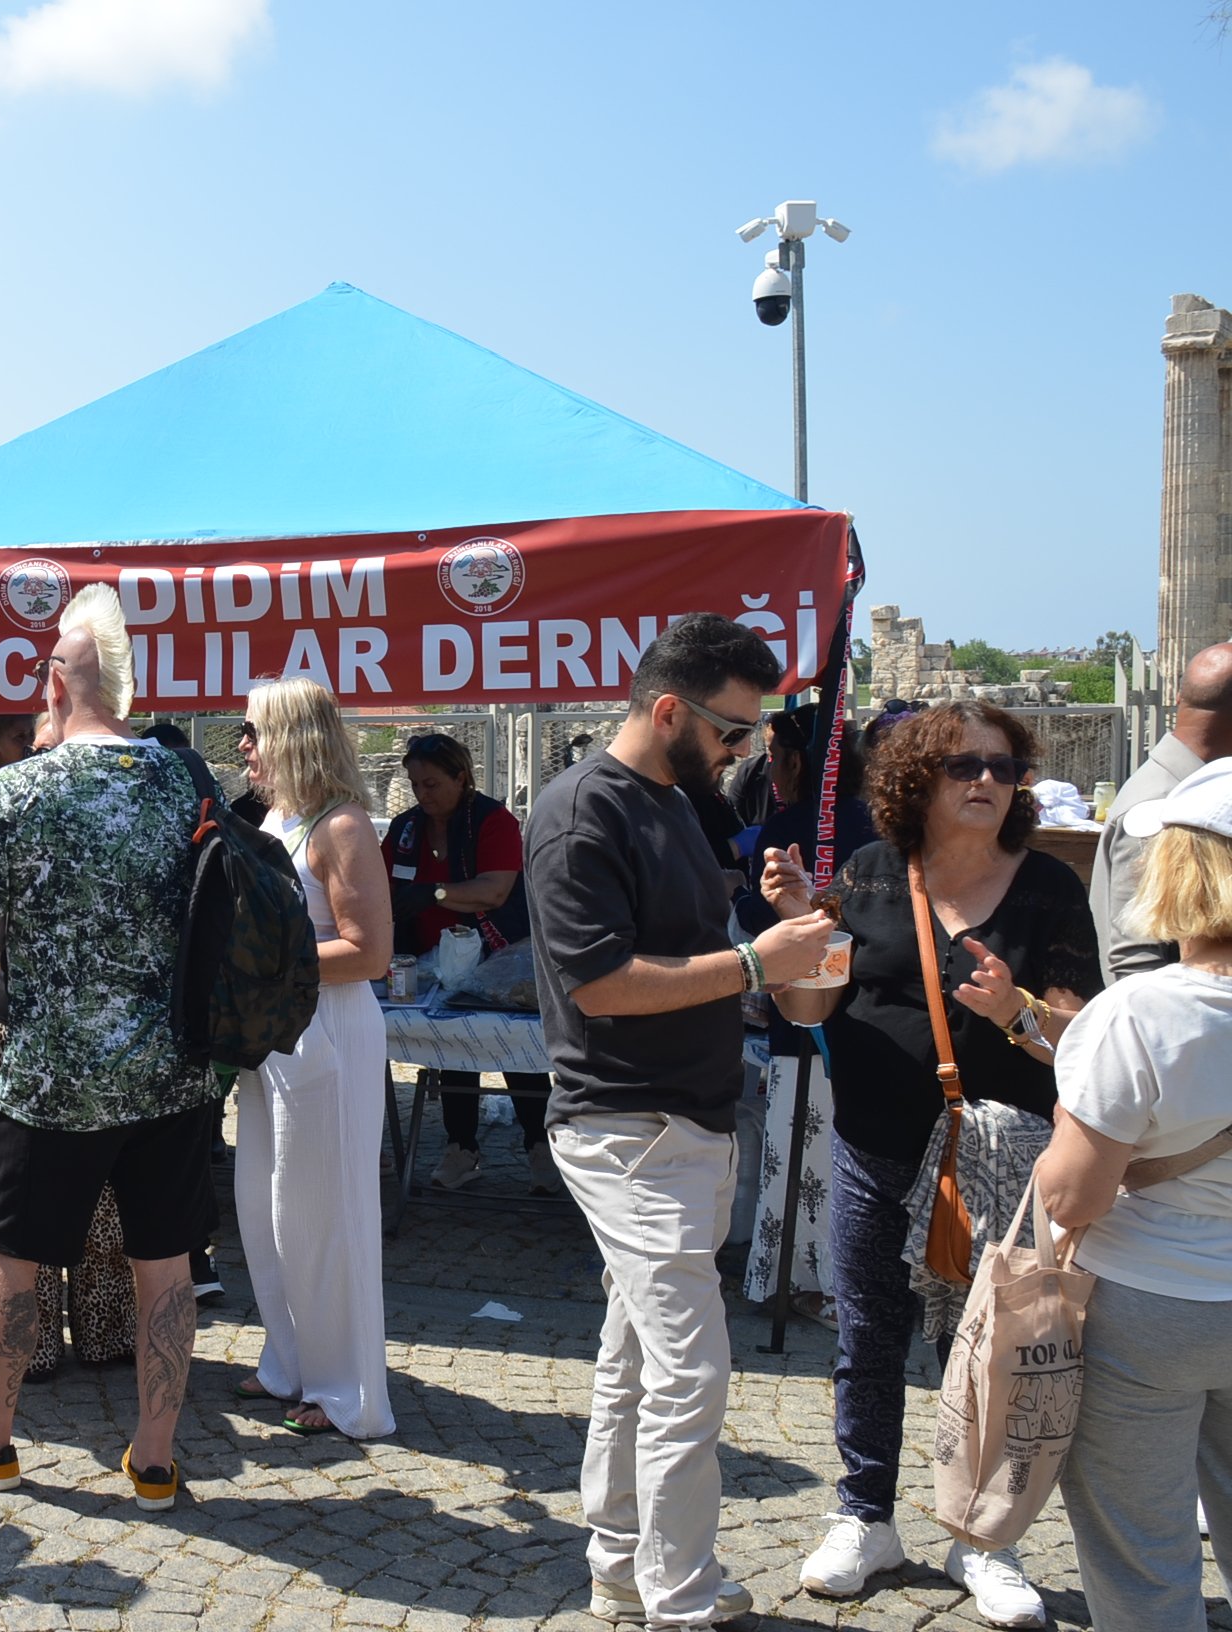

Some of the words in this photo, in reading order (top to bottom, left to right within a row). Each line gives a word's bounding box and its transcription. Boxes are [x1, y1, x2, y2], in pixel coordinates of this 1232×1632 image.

[119, 556, 387, 625] DİDİM
[473, 604, 493, 613] 2018
[30, 621, 46, 629] 2018
[1015, 1343, 1057, 1366] TOP
